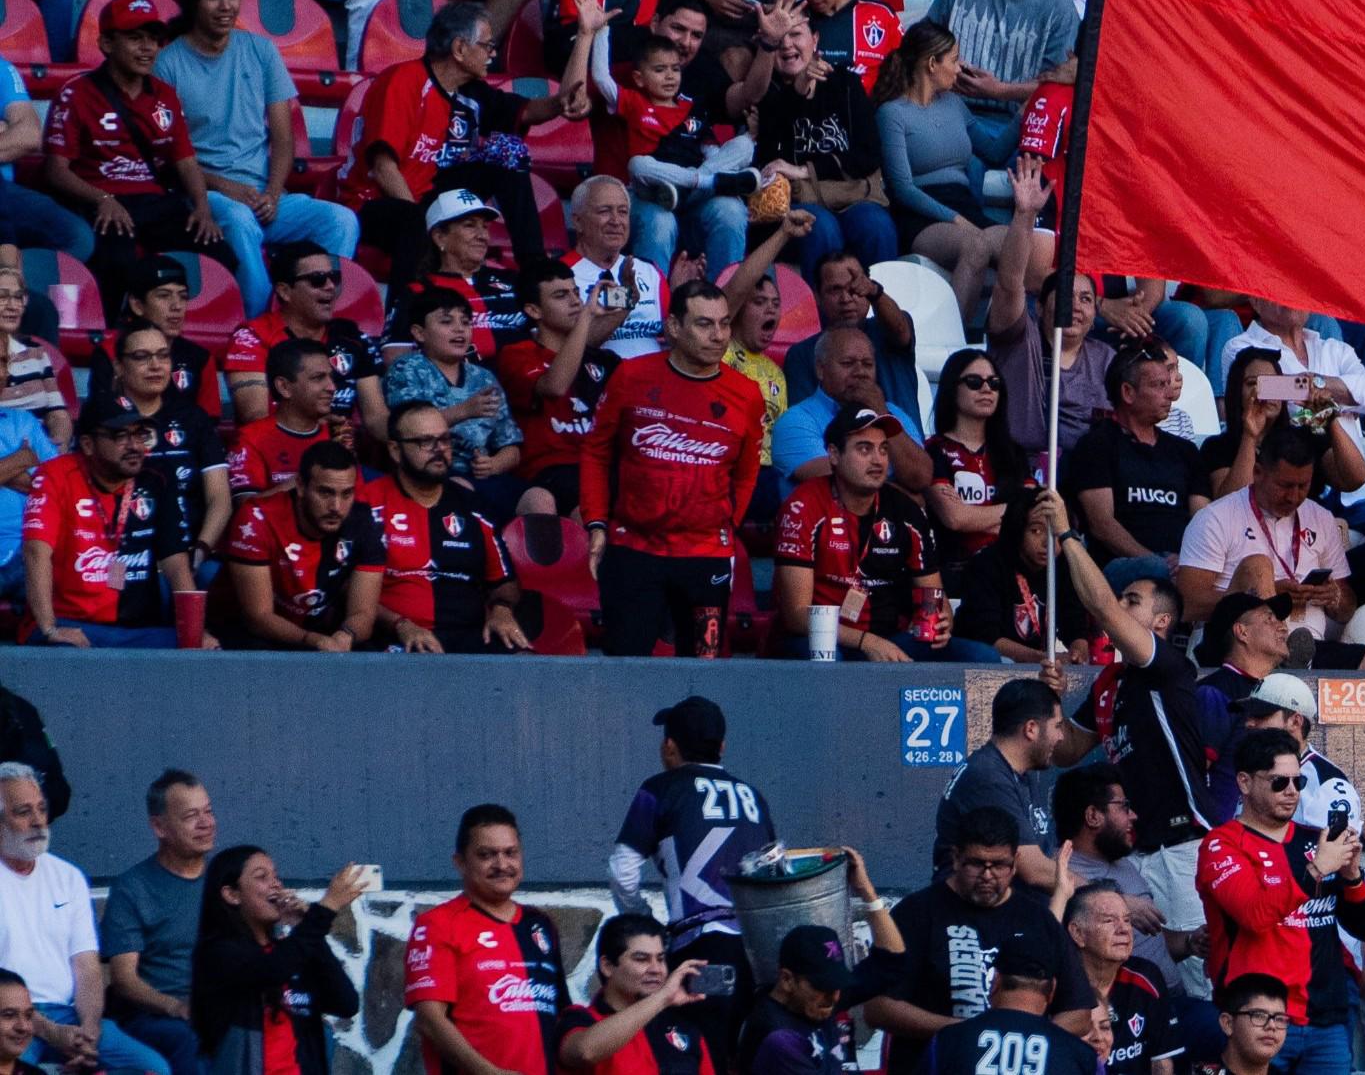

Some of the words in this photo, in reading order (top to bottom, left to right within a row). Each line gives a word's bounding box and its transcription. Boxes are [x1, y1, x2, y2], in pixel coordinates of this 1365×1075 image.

[1025, 114, 1050, 129] Red
[631, 423, 728, 457] Caliente
[1127, 486, 1178, 506] HUGO
[904, 689, 962, 702] SECCION
[904, 705, 960, 748] 27
[914, 750, 930, 764] 26
[939, 750, 954, 764] 28
[694, 777, 760, 824] 278
[1281, 914, 1338, 930] aliente.m
[947, 924, 986, 1019] RAIDERS
[975, 1029, 1049, 1075] 209
[1107, 1041, 1143, 1066] yecta
